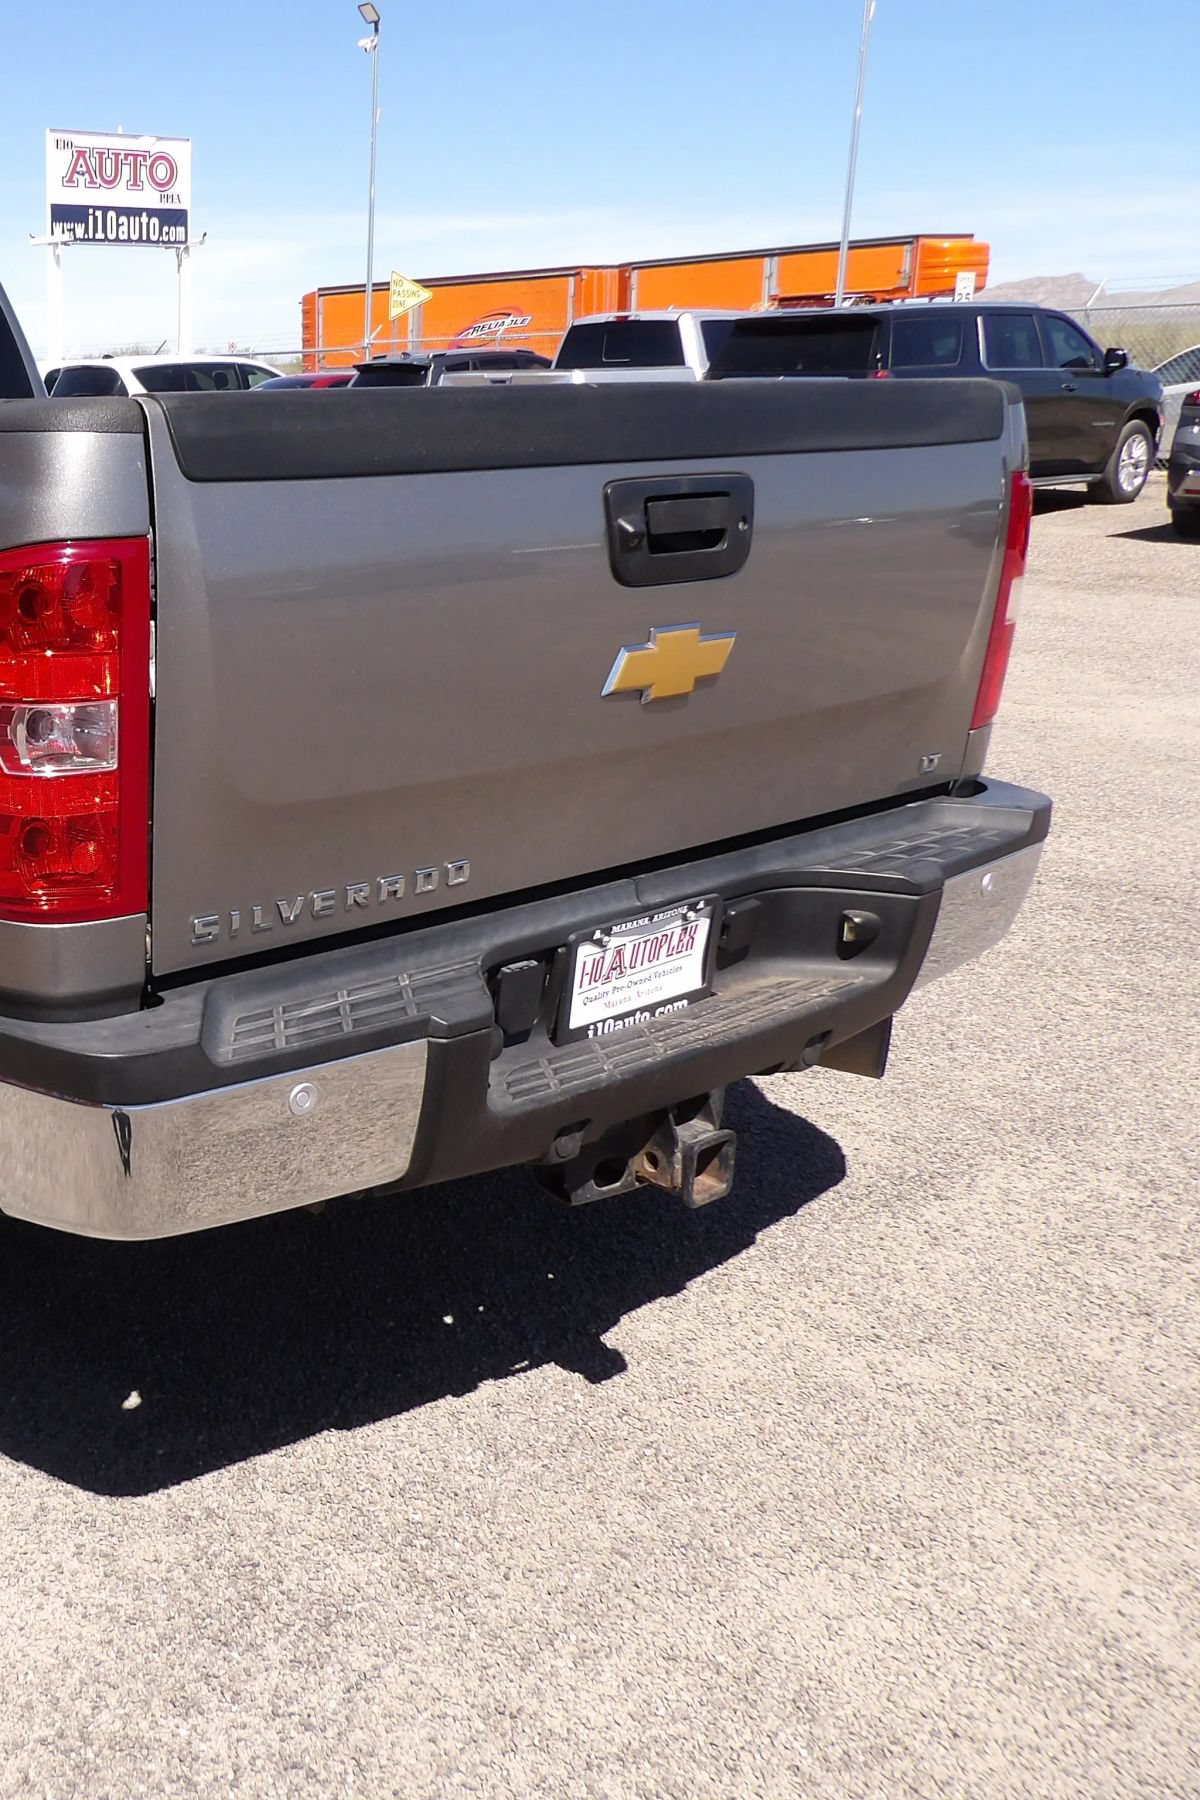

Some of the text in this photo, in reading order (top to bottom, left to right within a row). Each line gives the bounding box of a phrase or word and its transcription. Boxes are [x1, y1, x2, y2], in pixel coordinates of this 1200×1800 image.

[62, 146, 178, 192] AUTO
[52, 208, 186, 242] www.i10auto.com
[392, 289, 421, 299] PASSING
[393, 279, 404, 288] NO
[192, 858, 471, 945] SILVERADO
